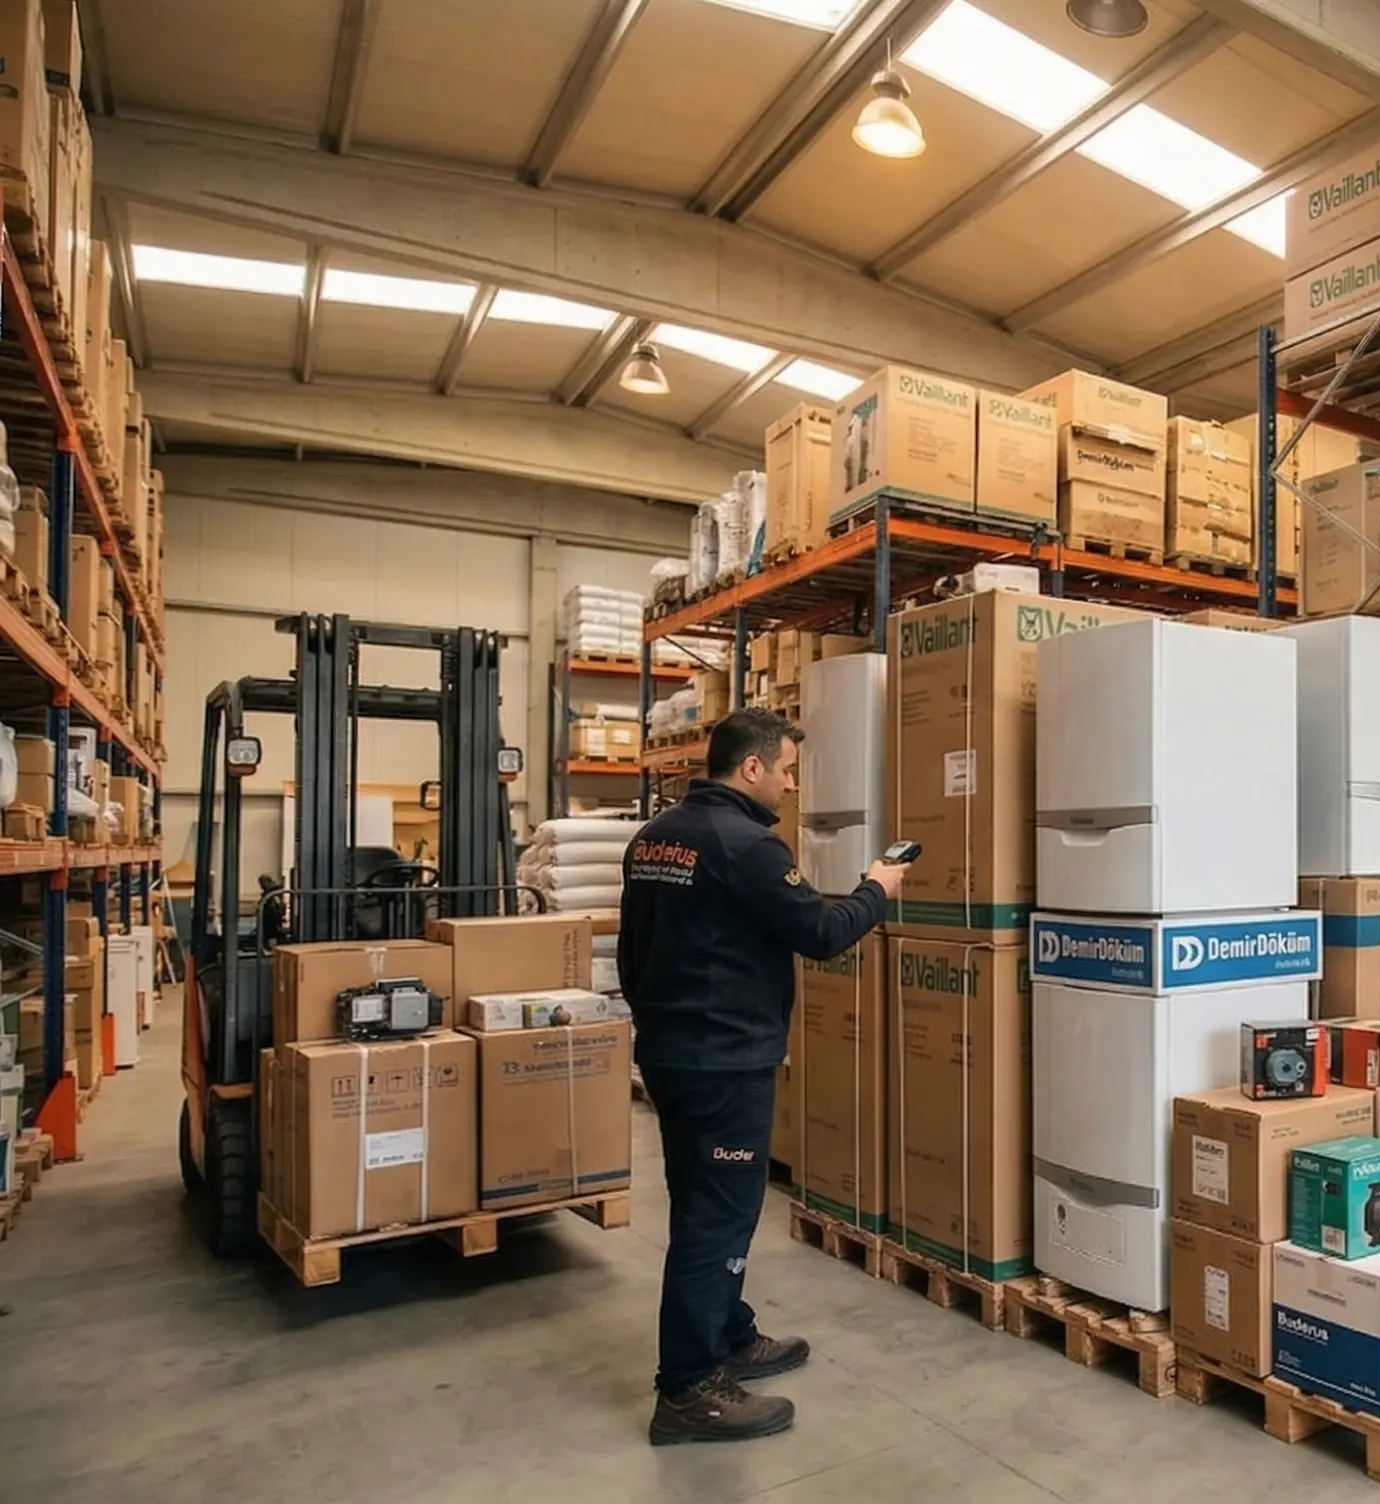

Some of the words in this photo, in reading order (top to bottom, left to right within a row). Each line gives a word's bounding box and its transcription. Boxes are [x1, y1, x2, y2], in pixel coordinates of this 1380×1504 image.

[914, 381, 969, 408] Vaillant
[1002, 402, 1052, 429] Vaillant
[915, 609, 978, 656] Vaillant
[1061, 933, 1145, 964] DemirDöküm
[1208, 931, 1311, 961] DemirDöküm
[915, 954, 980, 997] Vaillant
[1277, 1310, 1330, 1341] Buderus
